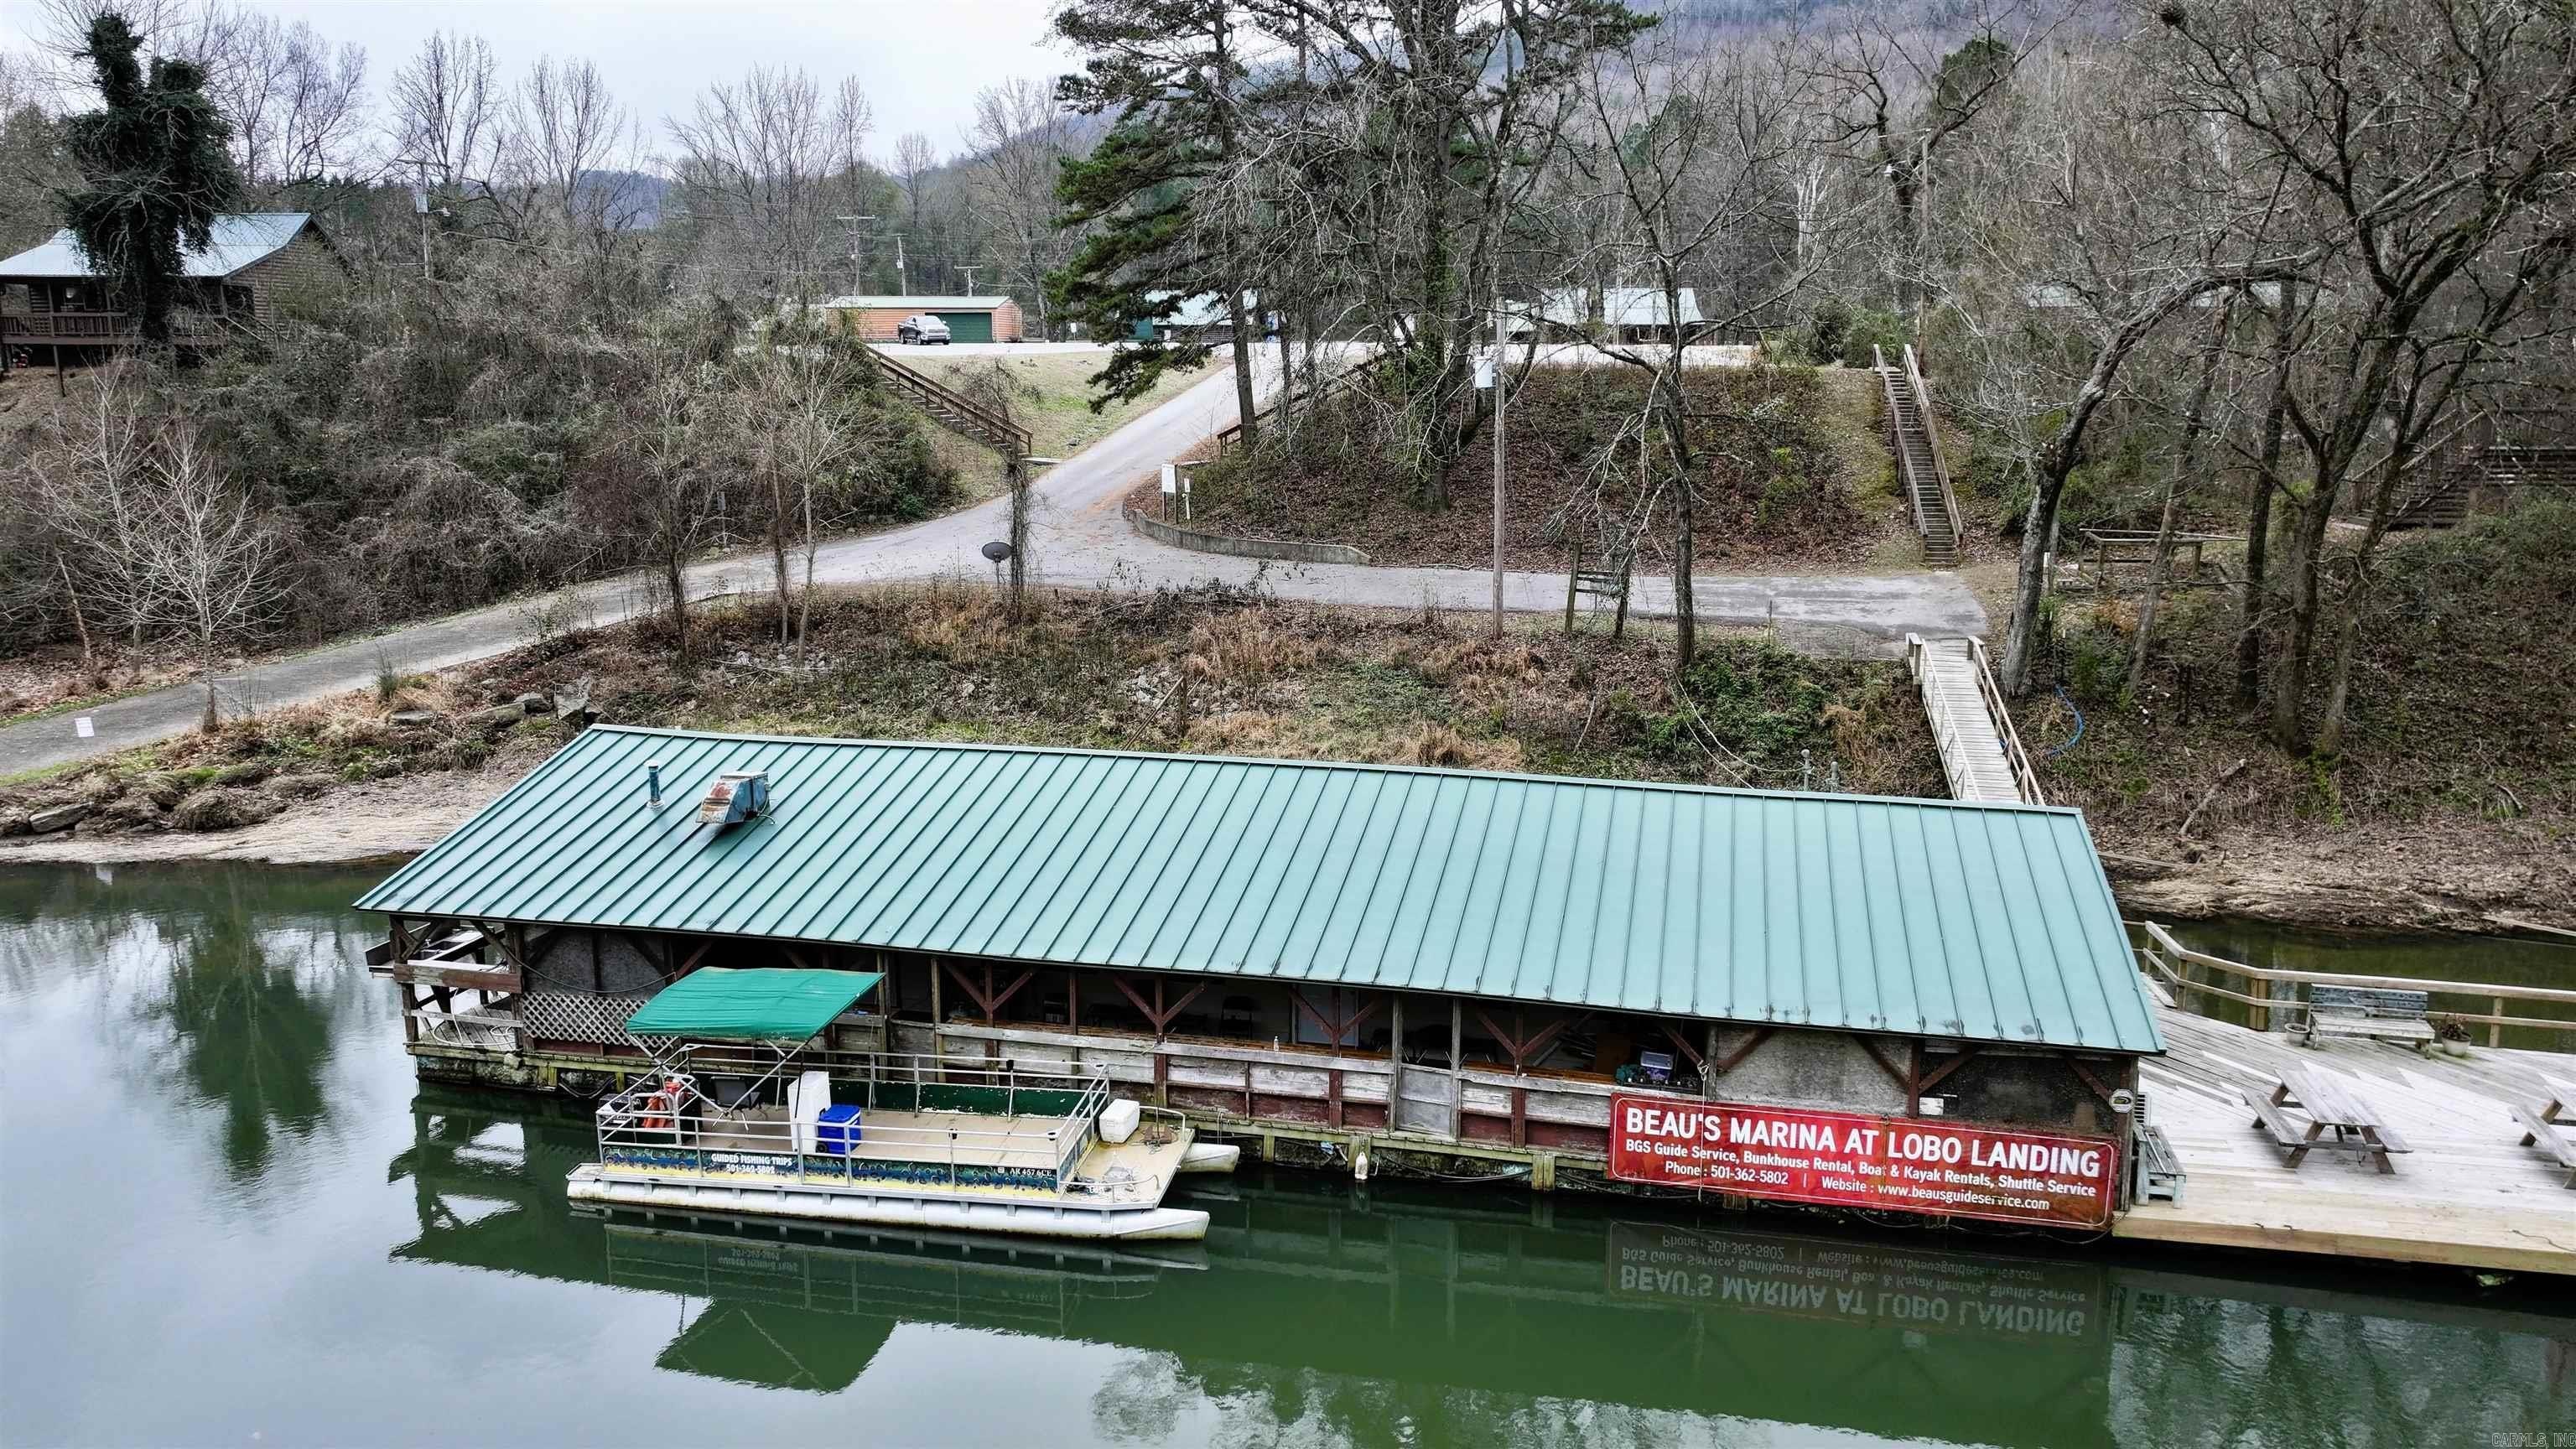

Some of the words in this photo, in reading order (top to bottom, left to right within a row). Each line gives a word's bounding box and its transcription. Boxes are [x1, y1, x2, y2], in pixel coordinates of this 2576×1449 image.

[1626, 1107, 1721, 1141] BEAU'S
[1730, 1118, 1836, 1153] MARINA
[1844, 1128, 1879, 1156] AT
[1888, 1132, 1962, 1164] LOBO
[1971, 1139, 2100, 1178] LANDING
[711, 1153, 739, 1164] GUIDED
[740, 1156, 771, 1166] FISHING
[771, 1157, 792, 1166] TRIPS
[726, 1164, 775, 1174] 501-362-5802
[1626, 1139, 1651, 1153] BGS
[1654, 1142, 1688, 1157] Guide
[1691, 1146, 1740, 1165] Service,
[1743, 1150, 1810, 1169] Bunkhouse
[1813, 1157, 1854, 1176] Rental,
[1890, 1165, 1900, 1178] &
[1903, 1166, 1941, 1184] Kayak
[1945, 1170, 1995, 1189] Rentals,
[1998, 1174, 2044, 1192] Shuttle
[2047, 1179, 2096, 1197] Service
[1665, 1161, 1701, 1176] Phone
[1711, 1165, 1789, 1186] 501-362-5802
[1822, 1176, 1867, 1192] Website
